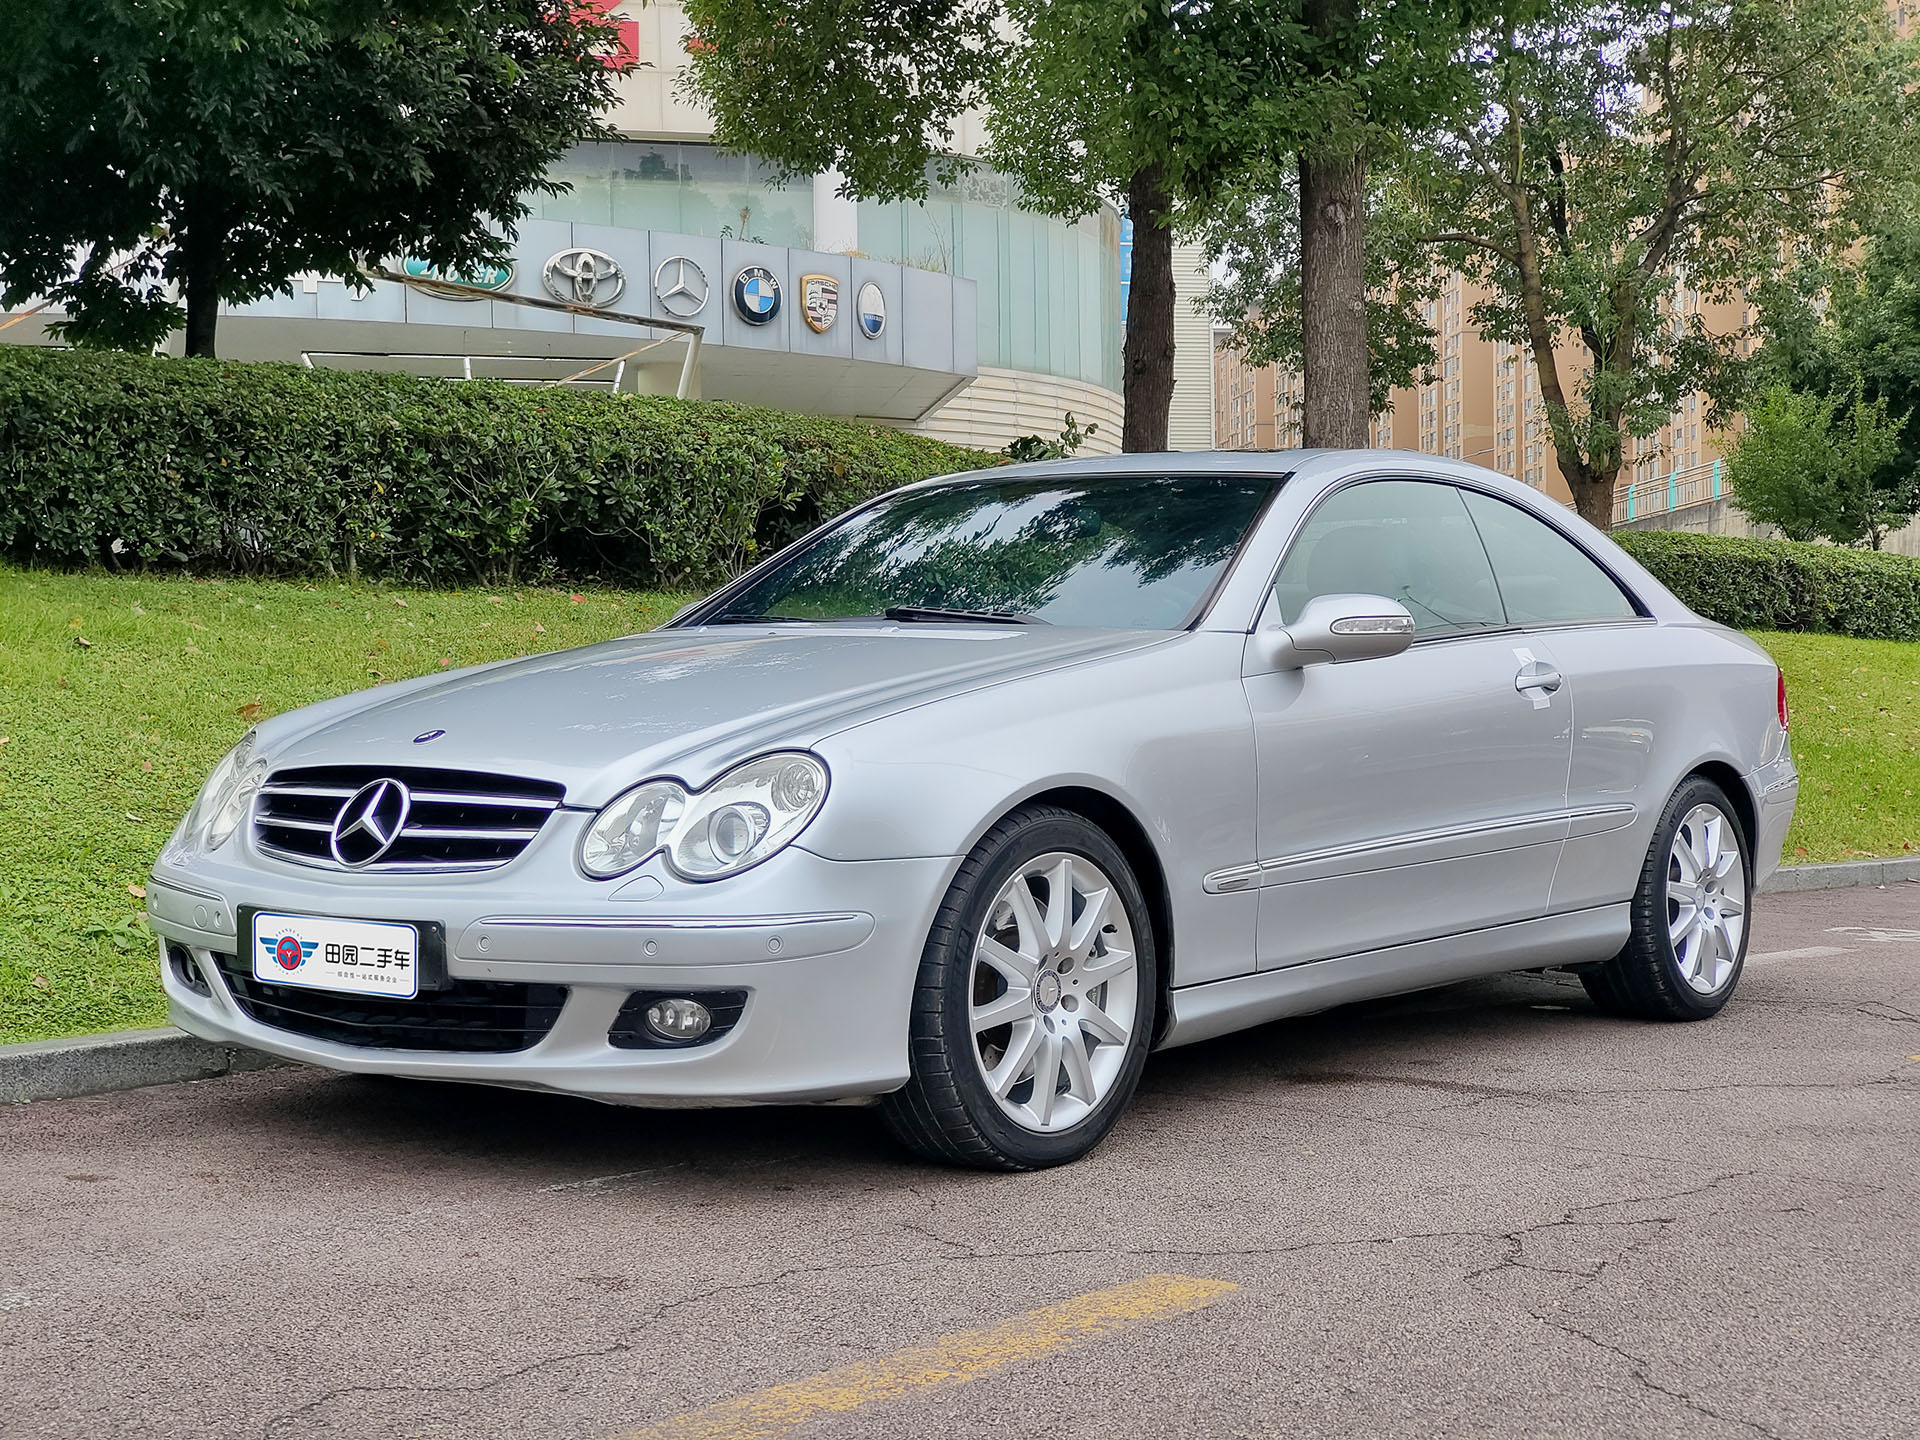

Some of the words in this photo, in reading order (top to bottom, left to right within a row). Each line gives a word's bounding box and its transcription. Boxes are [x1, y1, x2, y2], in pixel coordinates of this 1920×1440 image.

[739, 268, 778, 289] BMW
[806, 279, 839, 291] PORSCHE
[325, 943, 410, 970] 田园二手车
